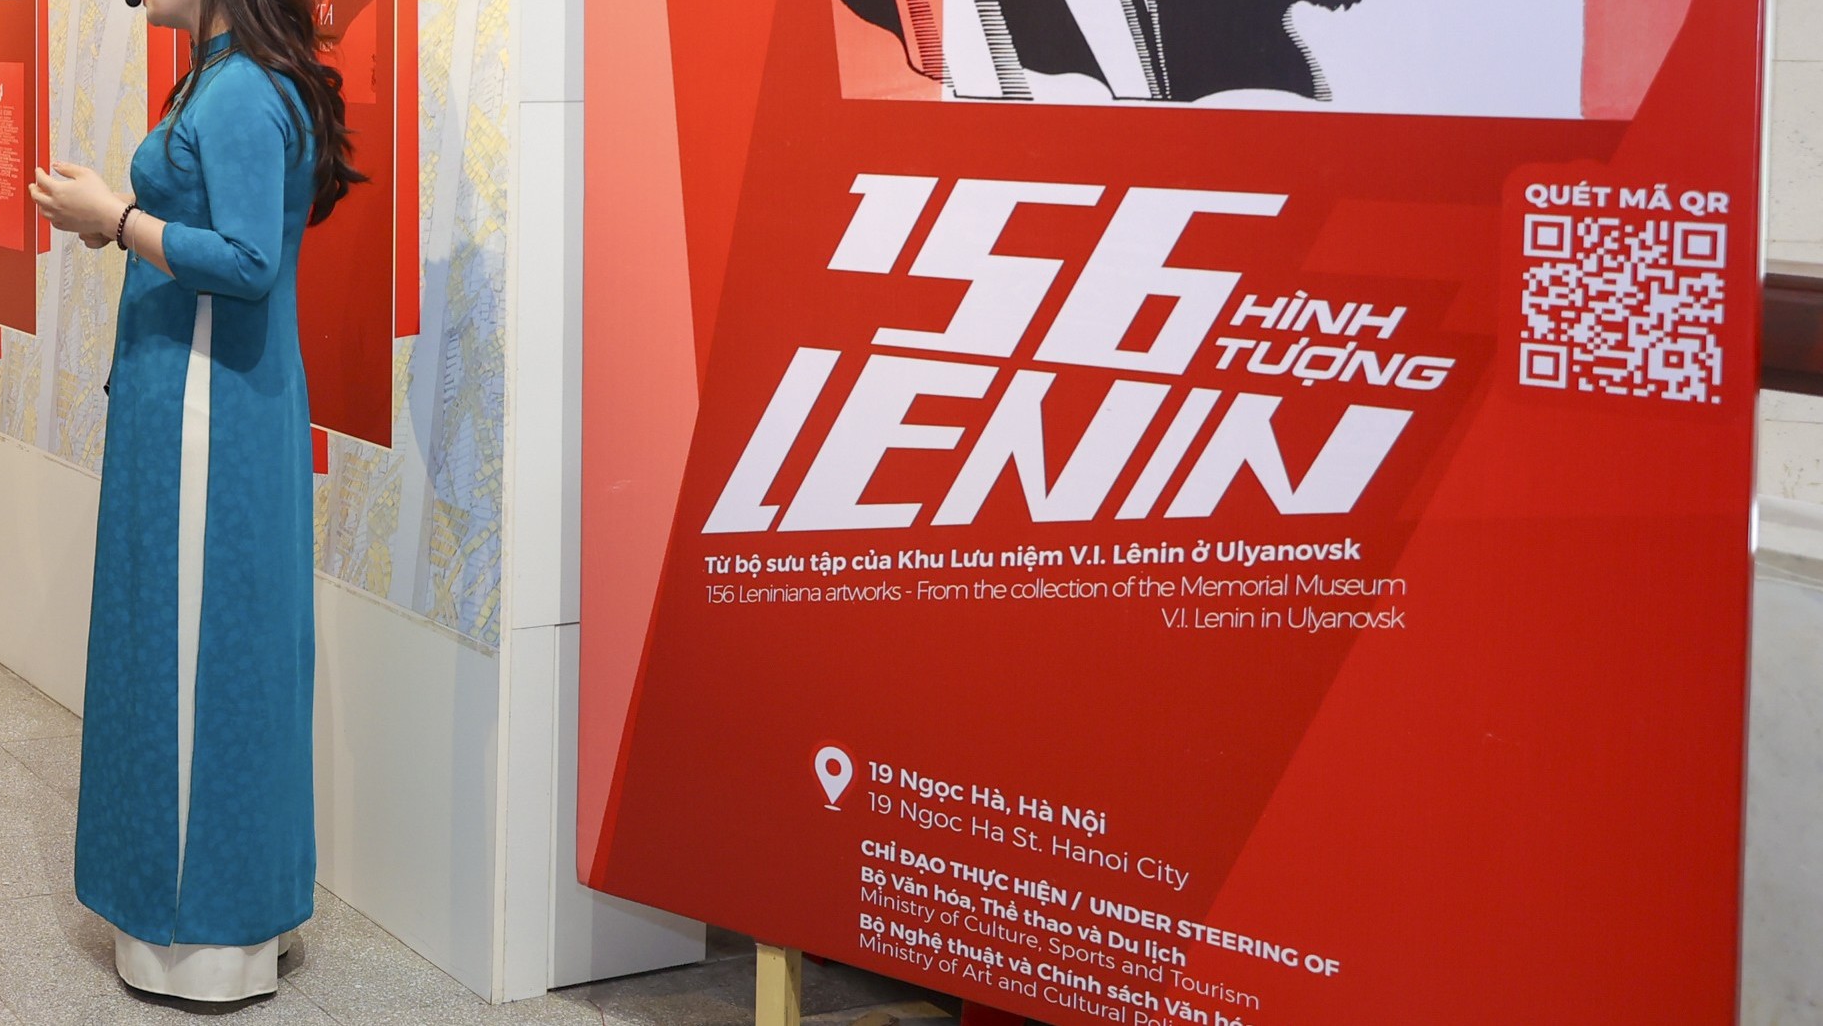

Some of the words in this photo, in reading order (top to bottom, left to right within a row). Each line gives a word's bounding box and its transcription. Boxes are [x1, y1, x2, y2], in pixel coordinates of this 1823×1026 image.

[1525, 181, 1611, 208] QUÉT
[1619, 183, 1672, 211] MÃ
[1679, 191, 1729, 214] QR
[1230, 290, 1406, 337] HÌNH
[1213, 337, 1455, 391] TƯỢNG
[700, 346, 1414, 534] LENIN
[704, 555, 730, 573] Từ
[735, 554, 762, 578] bộ
[766, 554, 805, 573] sưu
[809, 551, 846, 577] tập
[852, 550, 892, 571] của
[898, 549, 944, 569] Khu
[950, 549, 994, 568] Lưu
[1000, 545, 1063, 572] niệm
[1069, 545, 1105, 565] V.I.
[1113, 541, 1185, 564] Lênin
[1191, 540, 1211, 562] ở
[1216, 538, 1361, 567] Ulyanovsk
[706, 585, 734, 603] 156
[738, 583, 821, 603] Leniniana
[825, 581, 901, 601] artworks
[917, 580, 968, 600] From
[974, 579, 1007, 599] the
[1010, 578, 1108, 600] collection
[1112, 577, 1132, 598] of
[1138, 577, 1174, 597] the
[1181, 574, 1288, 597] Memorial
[1295, 575, 1406, 595] Museum
[1161, 608, 1188, 629] V.I.
[1195, 608, 1254, 628] Lenin
[1261, 607, 1280, 627] in
[1288, 606, 1406, 634] Ulyanovsk
[868, 761, 892, 784] 19
[900, 768, 963, 803] Ngọc
[971, 785, 1011, 815] Hà,
[1018, 795, 1053, 822] Hà
[1062, 806, 1106, 838] Nội
[868, 792, 892, 815] 19
[900, 799, 963, 832] Ngoc
[971, 816, 1004, 842] Ha
[1012, 827, 1043, 852] St.
[1052, 836, 1129, 873] Hanoi
[1137, 857, 1190, 891] City
[861, 840, 895, 862] CHỈ
[900, 848, 946, 874] ĐẠO
[950, 861, 1008, 891] THỰC
[1014, 878, 1067, 906] HIỆN
[1071, 892, 1082, 911] /
[1089, 897, 1171, 933] UNDER
[1177, 919, 1299, 967] STEERING
[1304, 954, 1340, 977] OF
[861, 866, 886, 890] Bộ
[891, 874, 928, 898] Văn
[934, 885, 976, 912] hóa,
[1024, 910, 1073, 936] thao
[1078, 925, 1102, 944] và
[1108, 931, 1138, 954] Du
[1145, 940, 1186, 967] lịch
[861, 886, 935, 923] Ministry
[940, 911, 959, 926] of
[964, 915, 1042, 951] Culture,
[1048, 937, 1116, 971] Sports
[1122, 959, 1163, 983] and
[1170, 970, 1259, 1010] Tourism
[859, 913, 885, 938] Bộ
[890, 922, 942, 954] Nghệ
[948, 937, 1003, 969] thuật
[1008, 957, 1032, 975] và
[1037, 963, 1102, 996] Chính
[1107, 985, 1159, 1011] sách
[1164, 998, 1208, 1026] Văn
[1214, 1011, 1254, 1026] hó
[859, 933, 933, 970] Ministry
[938, 959, 958, 974] of
[963, 964, 992, 986] Art
[998, 976, 1037, 998] and
[1043, 986, 1127, 1024] Cultural
